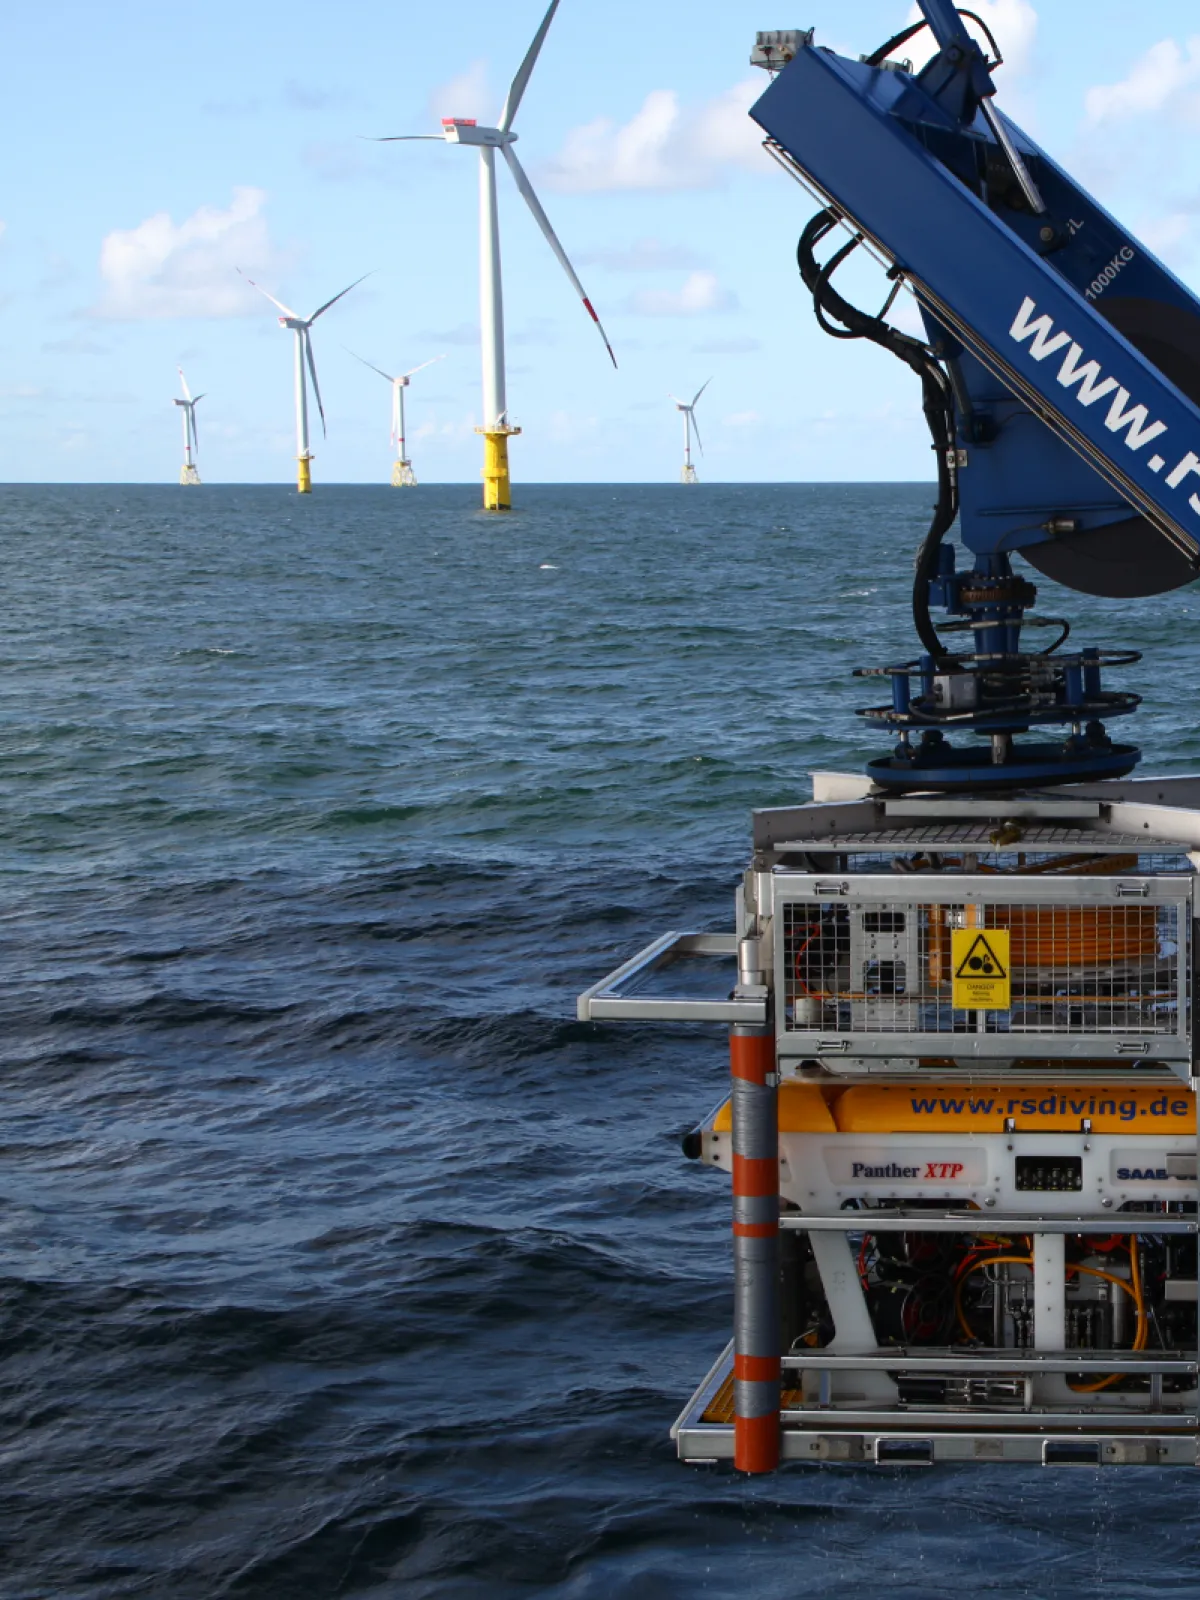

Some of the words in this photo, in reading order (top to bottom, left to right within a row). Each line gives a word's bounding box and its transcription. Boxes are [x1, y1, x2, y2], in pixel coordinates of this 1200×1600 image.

[910, 1096, 1188, 1121] www.rsdiving.de
[852, 1162, 920, 1178] Panther
[924, 1163, 964, 1178] XTP
[1117, 1168, 1169, 1180] SAAB
